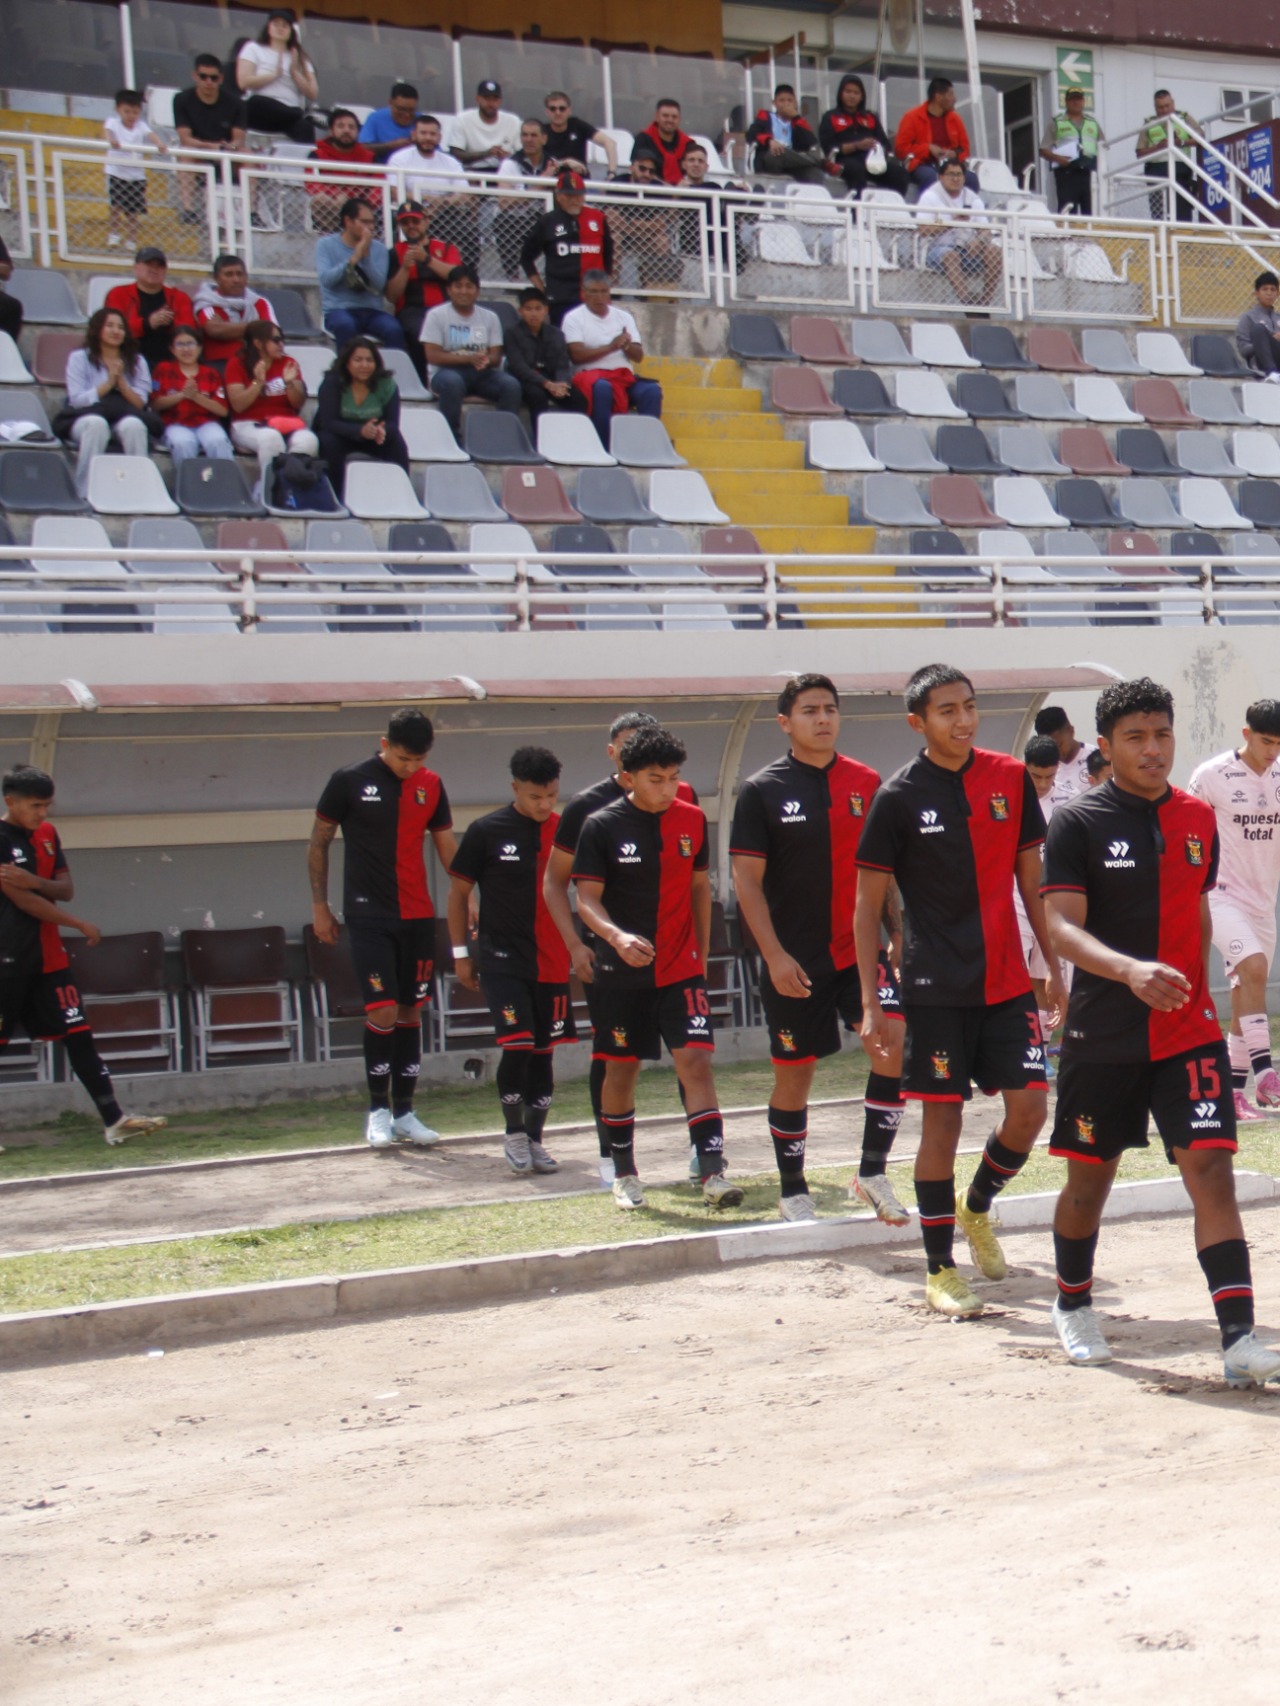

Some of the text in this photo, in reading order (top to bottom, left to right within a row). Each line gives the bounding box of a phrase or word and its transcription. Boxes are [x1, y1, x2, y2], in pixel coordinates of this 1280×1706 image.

[781, 814, 807, 824] walon
[919, 824, 945, 835] walon
[1243, 827, 1274, 842] total
[1104, 858, 1136, 869] walon
[55, 985, 80, 1010] 10
[684, 987, 710, 1017] 16
[553, 995, 567, 1021] 11
[687, 1028, 710, 1036] walon
[1024, 1011, 1043, 1047] 3
[1185, 1056, 1221, 1101] 15
[1191, 1119, 1221, 1130] walon
